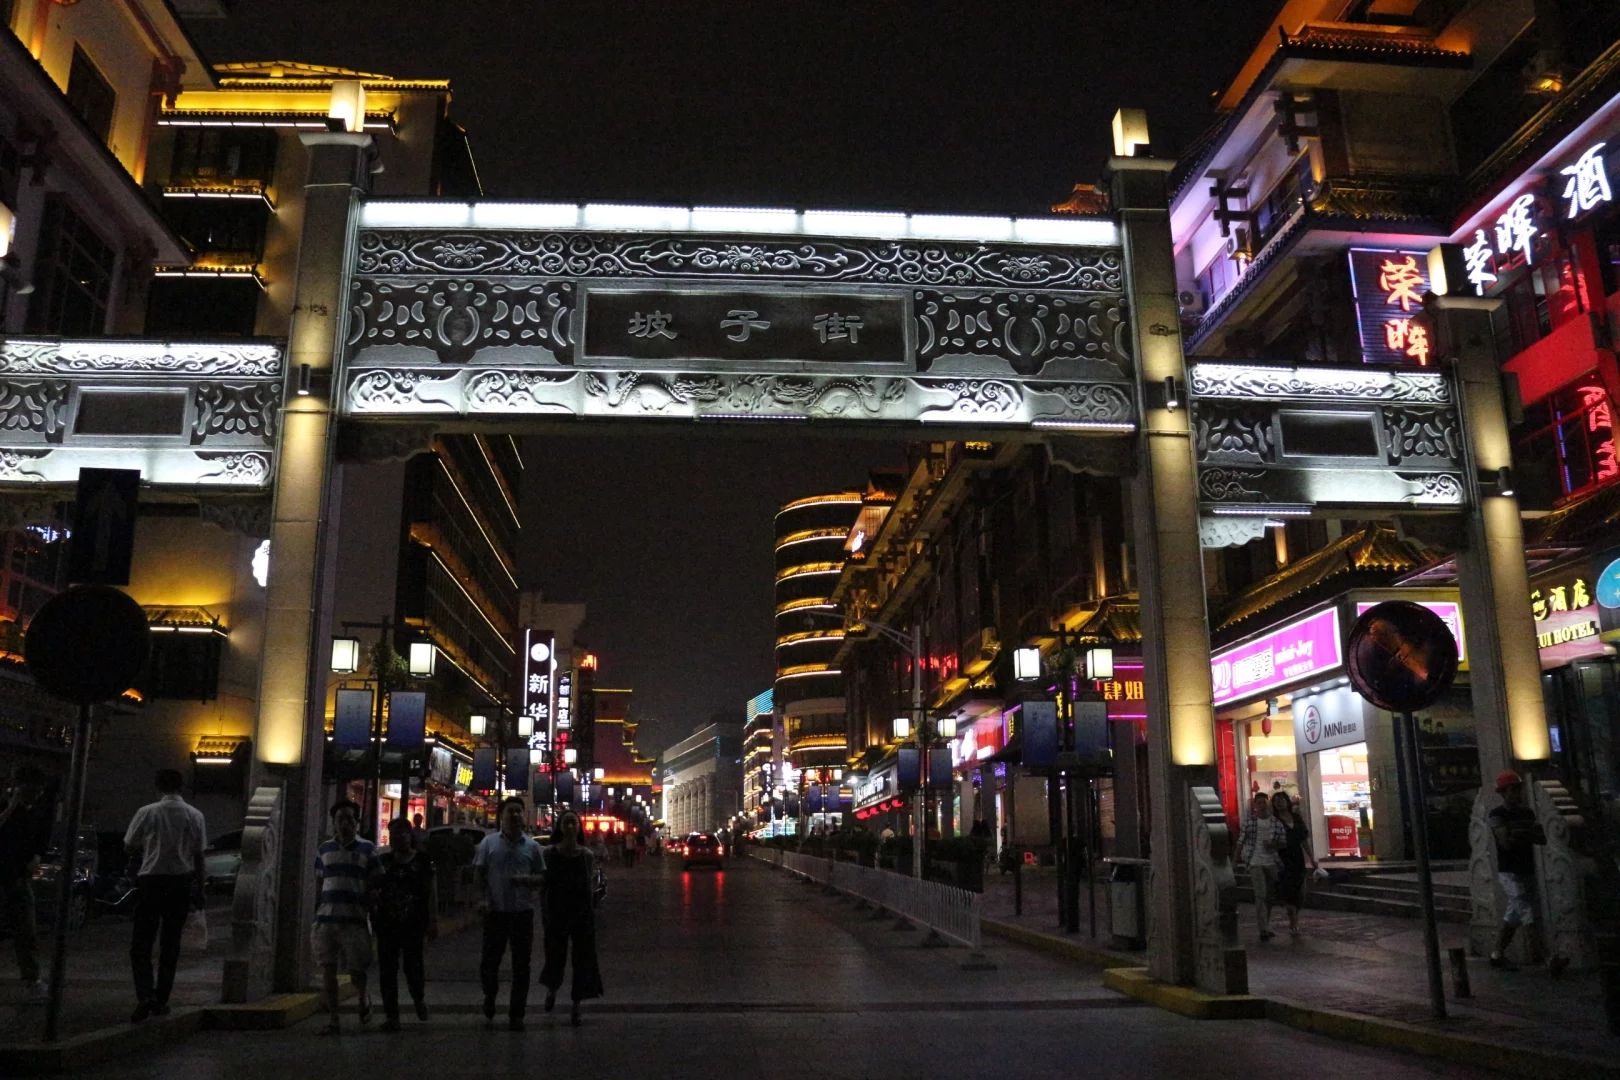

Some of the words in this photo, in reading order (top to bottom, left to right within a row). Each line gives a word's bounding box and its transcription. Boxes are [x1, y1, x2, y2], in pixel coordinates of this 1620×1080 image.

[627, 309, 865, 344] 坡子街
[1537, 631, 1552, 648] UI
[1553, 621, 1595, 645] HOTEL
[1104, 681, 1145, 701] 肆姐
[1324, 721, 1343, 738] MINI
[1331, 825, 1352, 835] meiji
